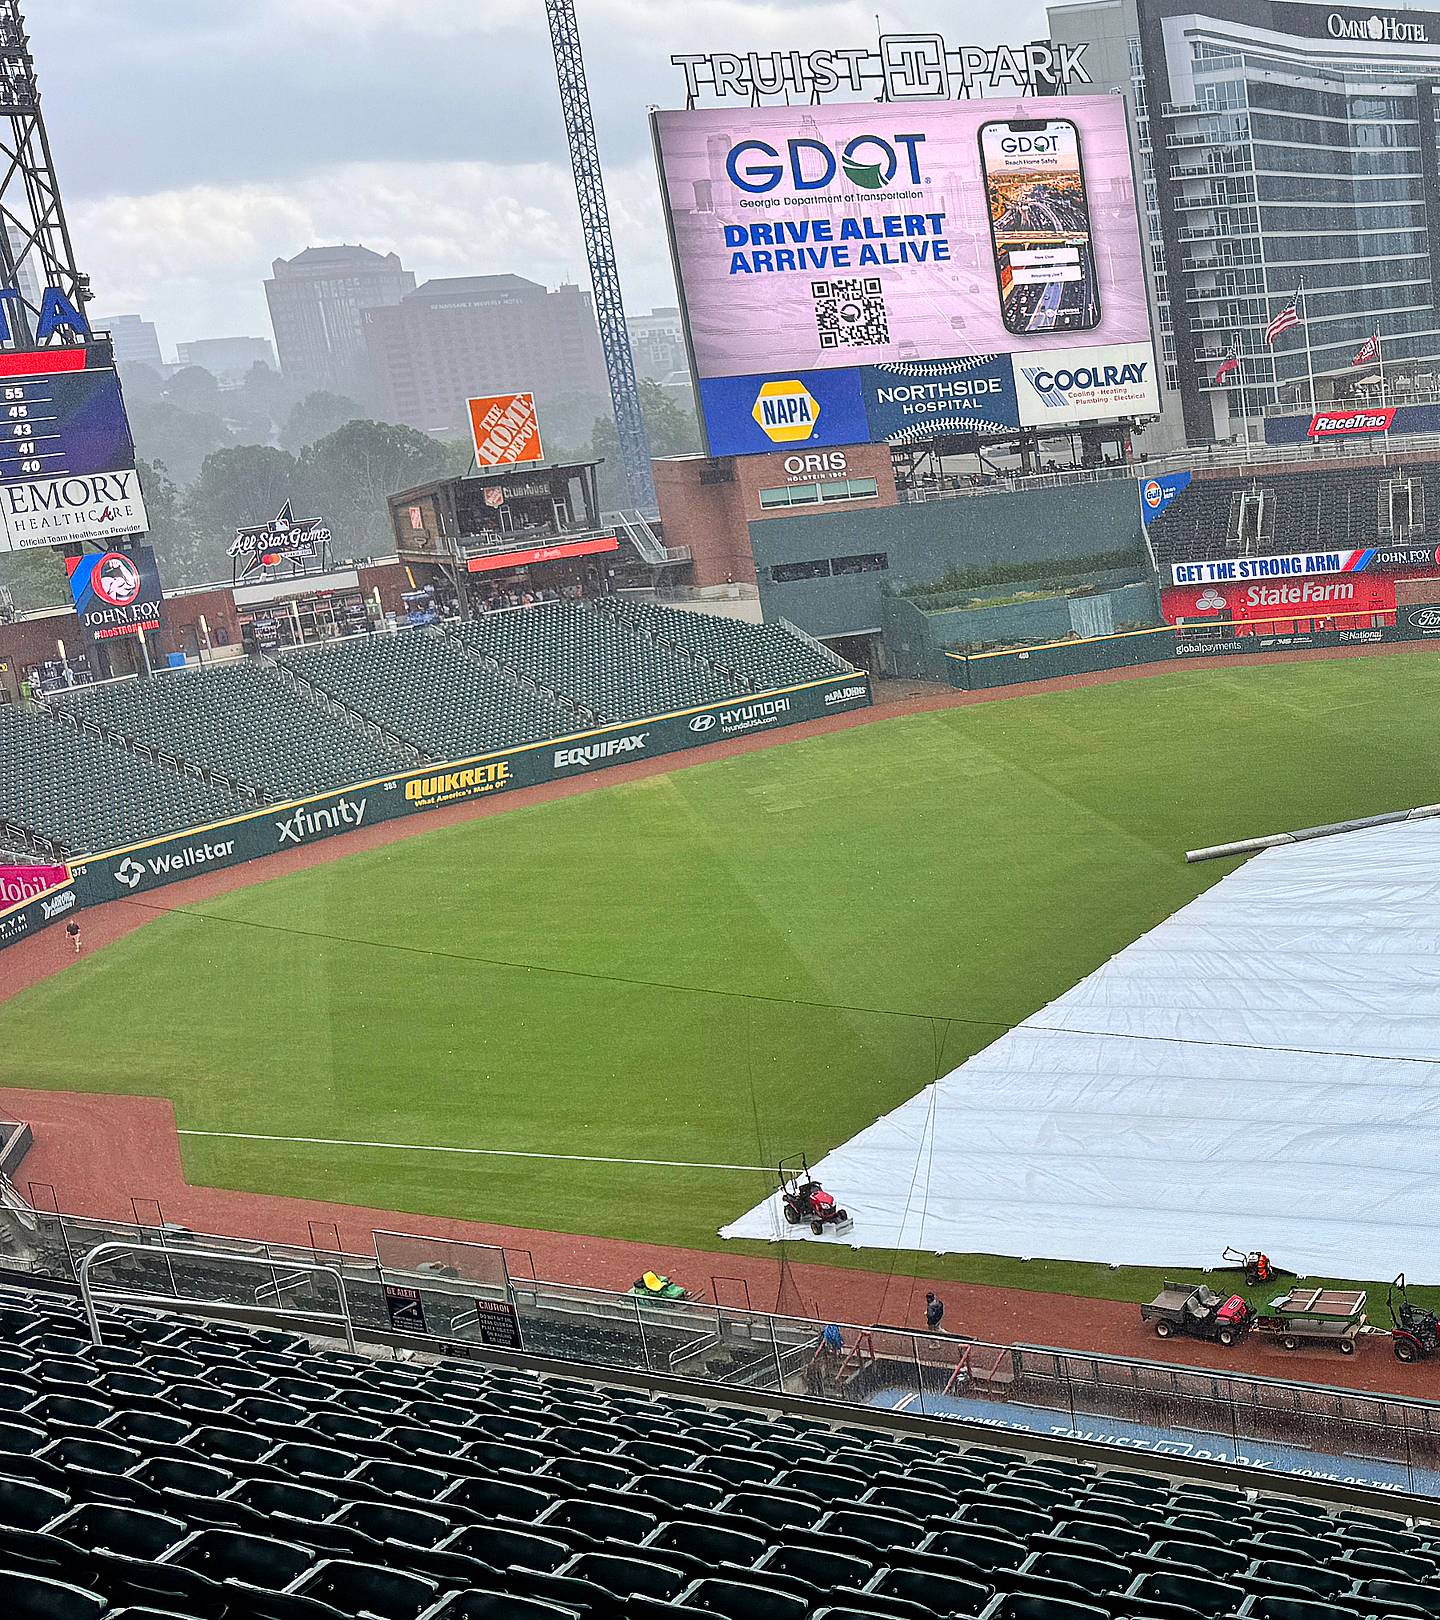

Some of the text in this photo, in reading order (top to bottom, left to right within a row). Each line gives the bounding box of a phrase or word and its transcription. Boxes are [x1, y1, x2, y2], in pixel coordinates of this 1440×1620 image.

[671, 43, 1094, 97] TRUIST PARK
[1001, 135, 1059, 153] GDOT
[725, 133, 926, 194] GDOT
[739, 197, 781, 209] Georgia
[783, 194, 843, 207] Department
[855, 190, 924, 203] Transportation
[723, 213, 946, 248] DRIVE ALERT
[729, 239, 951, 274] ARRIVE ALIVE
[1033, 361, 1148, 393] COOLRAY
[5, 387, 24, 400] 55
[877, 377, 1002, 403] NORTHSIDE
[8, 405, 28, 418] 45
[479, 403, 505, 433] THE
[762, 395, 811, 427] NAPA
[902, 397, 983, 416] HOSPITAL
[13, 424, 32, 436] 43
[477, 393, 536, 465] HOME
[1314, 413, 1387, 432] RaceTrac
[18, 442, 35, 455] 41
[503, 417, 539, 463] DEPOT
[21, 460, 41, 473] 40
[784, 451, 847, 475] ORIS
[5, 472, 132, 515] EMORY
[503, 483, 551, 498] CLUBHOUSE
[14, 504, 134, 532] HEALTHCARE
[47, 533, 69, 547] Team
[68, 528, 110, 542] Healthcare
[257, 531, 291, 551] Star
[1176, 553, 1341, 583] GET THE STRONG ARM
[1376, 551, 1407, 564] JOHN
[84, 600, 160, 627] JOHN FOY
[1349, 629, 1383, 640] National
[1175, 640, 1242, 655] globalpayments
[720, 698, 791, 725] HYUNDAI
[554, 733, 647, 769] EQUIFAX
[384, 781, 397, 792] 385
[405, 760, 510, 801] QUIKRETE
[414, 796, 436, 808] What
[435, 789, 473, 804] America's
[473, 784, 494, 795] Made
[275, 797, 367, 843] xfinity
[147, 840, 235, 876] Wellstar
[72, 866, 88, 877] 375
[0, 913, 27, 933] TYM
